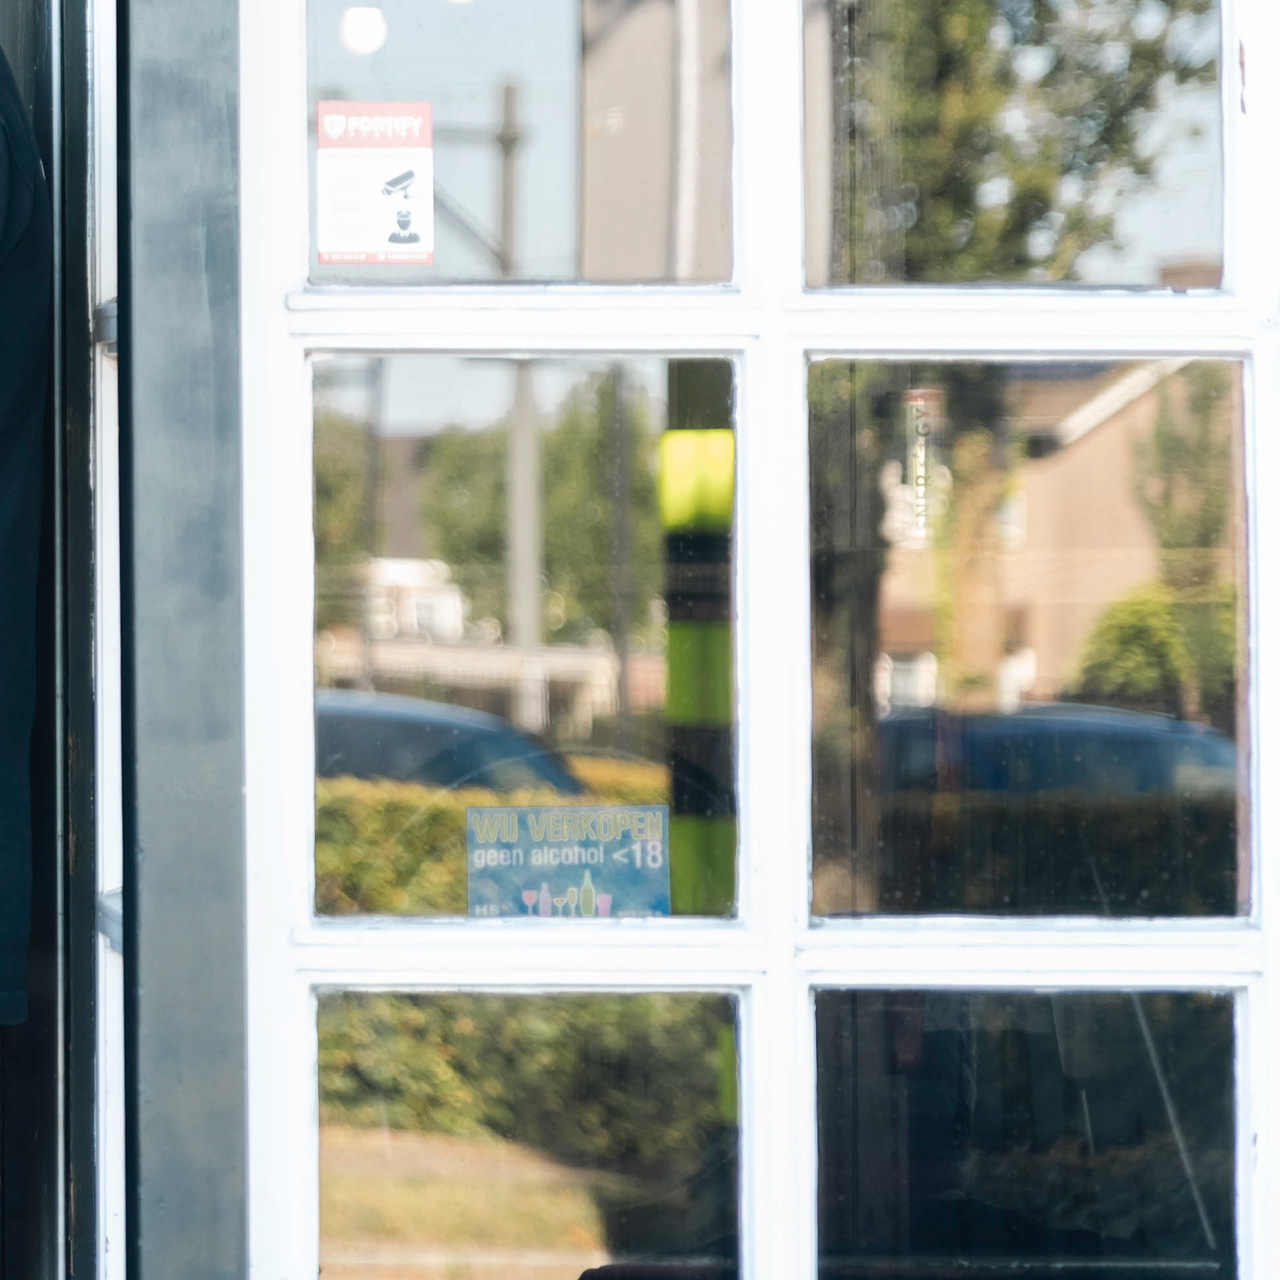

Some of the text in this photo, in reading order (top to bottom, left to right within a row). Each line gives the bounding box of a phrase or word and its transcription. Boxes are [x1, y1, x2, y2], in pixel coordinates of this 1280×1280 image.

[473, 811, 663, 843] WIJ VERKOPEN
[473, 841, 664, 869] geen alcohol <18
